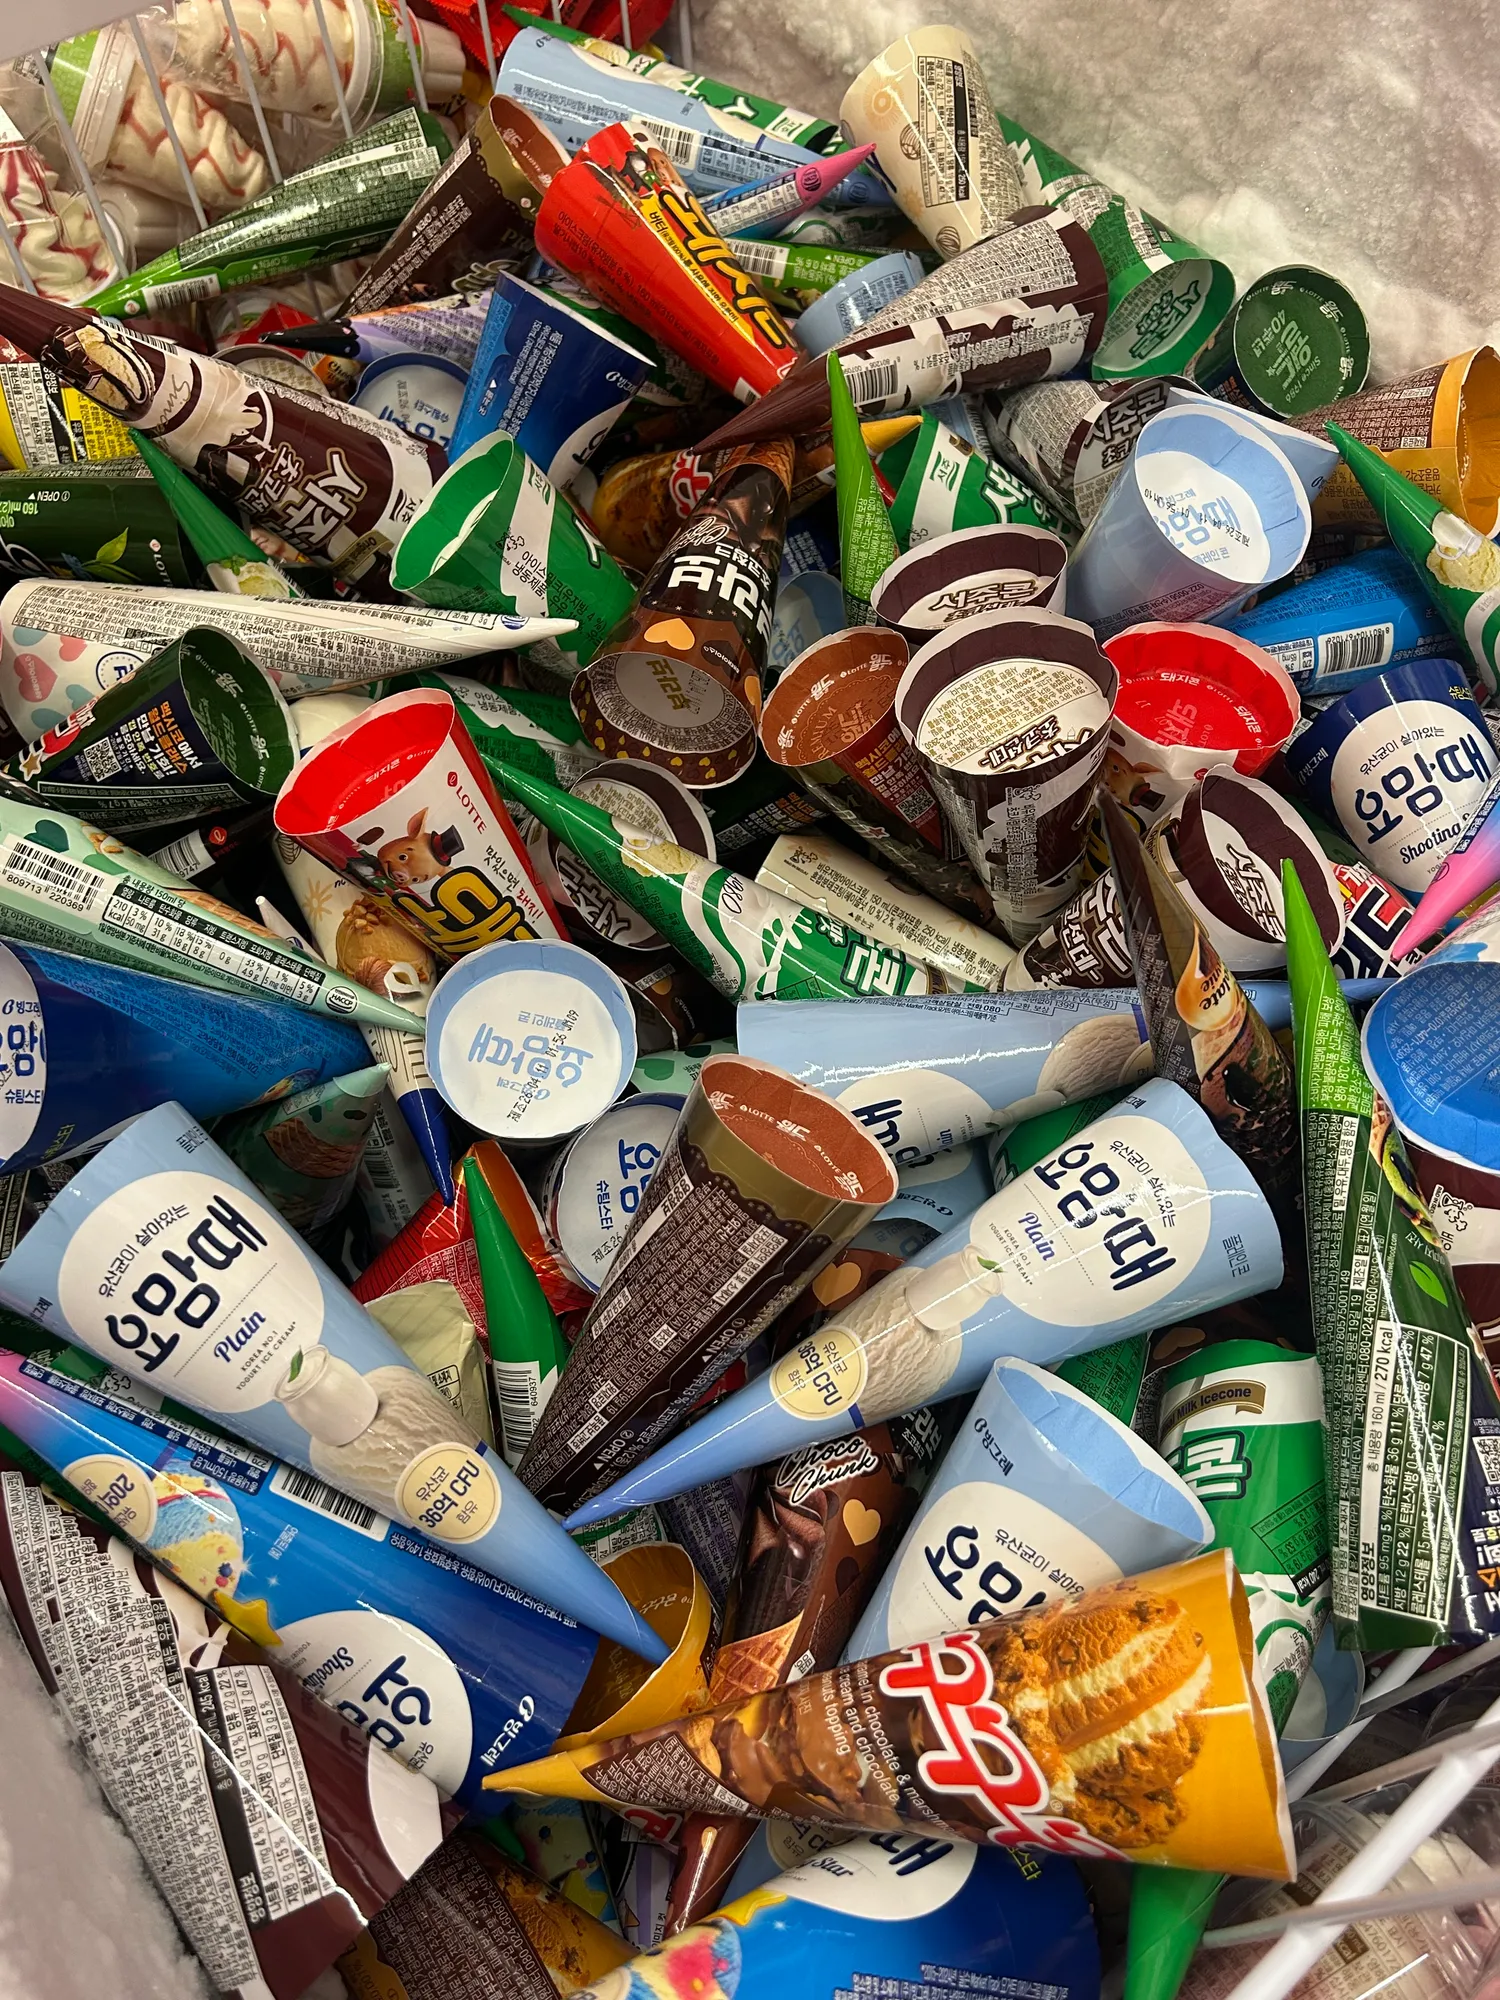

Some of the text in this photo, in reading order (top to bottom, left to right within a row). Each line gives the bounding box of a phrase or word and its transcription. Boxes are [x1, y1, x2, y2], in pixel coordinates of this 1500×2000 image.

[1129, 278, 1202, 361] 서주콘
[1252, 309, 1287, 358] 40주년
[1284, 354, 1322, 404] Since 1986
[22, 501, 38, 514] 160
[37, 490, 60, 500] OPEN
[856, 497, 868, 512] 보상
[511, 564, 547, 601] 냉동제품,
[925, 576, 1039, 614] 서주콘
[1004, 667, 1047, 695] www.seoju.kr
[1159, 671, 1200, 685] 돼지콘
[795, 691, 813, 715] LOTTE
[131, 712, 177, 779] 만날 기회!
[142, 707, 191, 777] 월드클래스
[154, 700, 204, 771] 멕시코에서
[1359, 724, 1447, 778] 유산균이 살아있는
[1304, 746, 1331, 784] 빙그레
[1354, 733, 1492, 846] 요맘때
[456, 786, 487, 834] LOTTE
[6, 873, 84, 913] 809713 220369
[130, 878, 178, 905] 내용량 150ml
[486, 845, 546, 925] 맛있으면 돼지!
[107, 907, 125, 923] kcal
[112, 898, 129, 913] 210
[137, 893, 322, 983] 나트륨 탄수화물 지방 트랜스지방 포화지방 콜레스테롤 단백질
[330, 992, 354, 1008] HACCP
[465, 1021, 595, 1091] 요맘때
[544, 1030, 567, 1059] 01:56
[747, 1106, 775, 1124] LOTTE
[1342, 1119, 1356, 1137] 함유
[1109, 1138, 1153, 1178] 유산균이
[595, 1179, 615, 1232] 슈팅스타
[1034, 1141, 1177, 1292] 요맘때
[98, 1202, 190, 1299] 유산균이 살아있는
[753, 1232, 784, 1264] 영업장의
[988, 1222, 1007, 1249] YOGURT
[1018, 1211, 1057, 1262] Plain
[105, 1195, 268, 1373] 요맘때
[740, 1258, 760, 1277] 명칭
[1352, 1257, 1367, 1287] 제조일
[714, 1279, 739, 1305] 소재지
[213, 1310, 267, 1364] Plain
[660, 1334, 684, 1357] 서울시
[704, 1324, 735, 1355] OPEN
[235, 1362, 262, 1391] YOGURT
[240, 1348, 264, 1373] KOREA
[639, 1351, 667, 1379] 영등포구
[822, 1340, 849, 1376] 유산균
[812, 1373, 843, 1407] CFU
[1177, 1384, 1253, 1420] Milk Icecone
[596, 1434, 625, 1465] OPEN
[777, 1436, 865, 1487] Choco
[984, 1429, 1015, 1476] 빙그레
[1355, 1326, 1393, 1601] 영양정보 내용량 160 270 kcal
[415, 1466, 449, 1502] 유산균
[418, 1463, 481, 1530] 36억 CFU
[791, 1450, 881, 1505] Chunk
[1382, 1463, 1399, 1506] 탄수화물
[456, 1497, 480, 1526] 함유
[1399, 1471, 1419, 1524] 트랜스지방
[994, 1528, 1050, 1571] 유산균이
[1374, 1573, 1392, 1606] 나트륨
[1392, 1586, 1407, 1609] 지방
[1411, 1558, 1432, 1613] 콜레스테롤
[480, 1719, 523, 1767] 빙그레
[819, 1702, 855, 1757] topping
[833, 1673, 901, 1810] cream and chocolate,
[862, 1703, 902, 1773] chocolate
